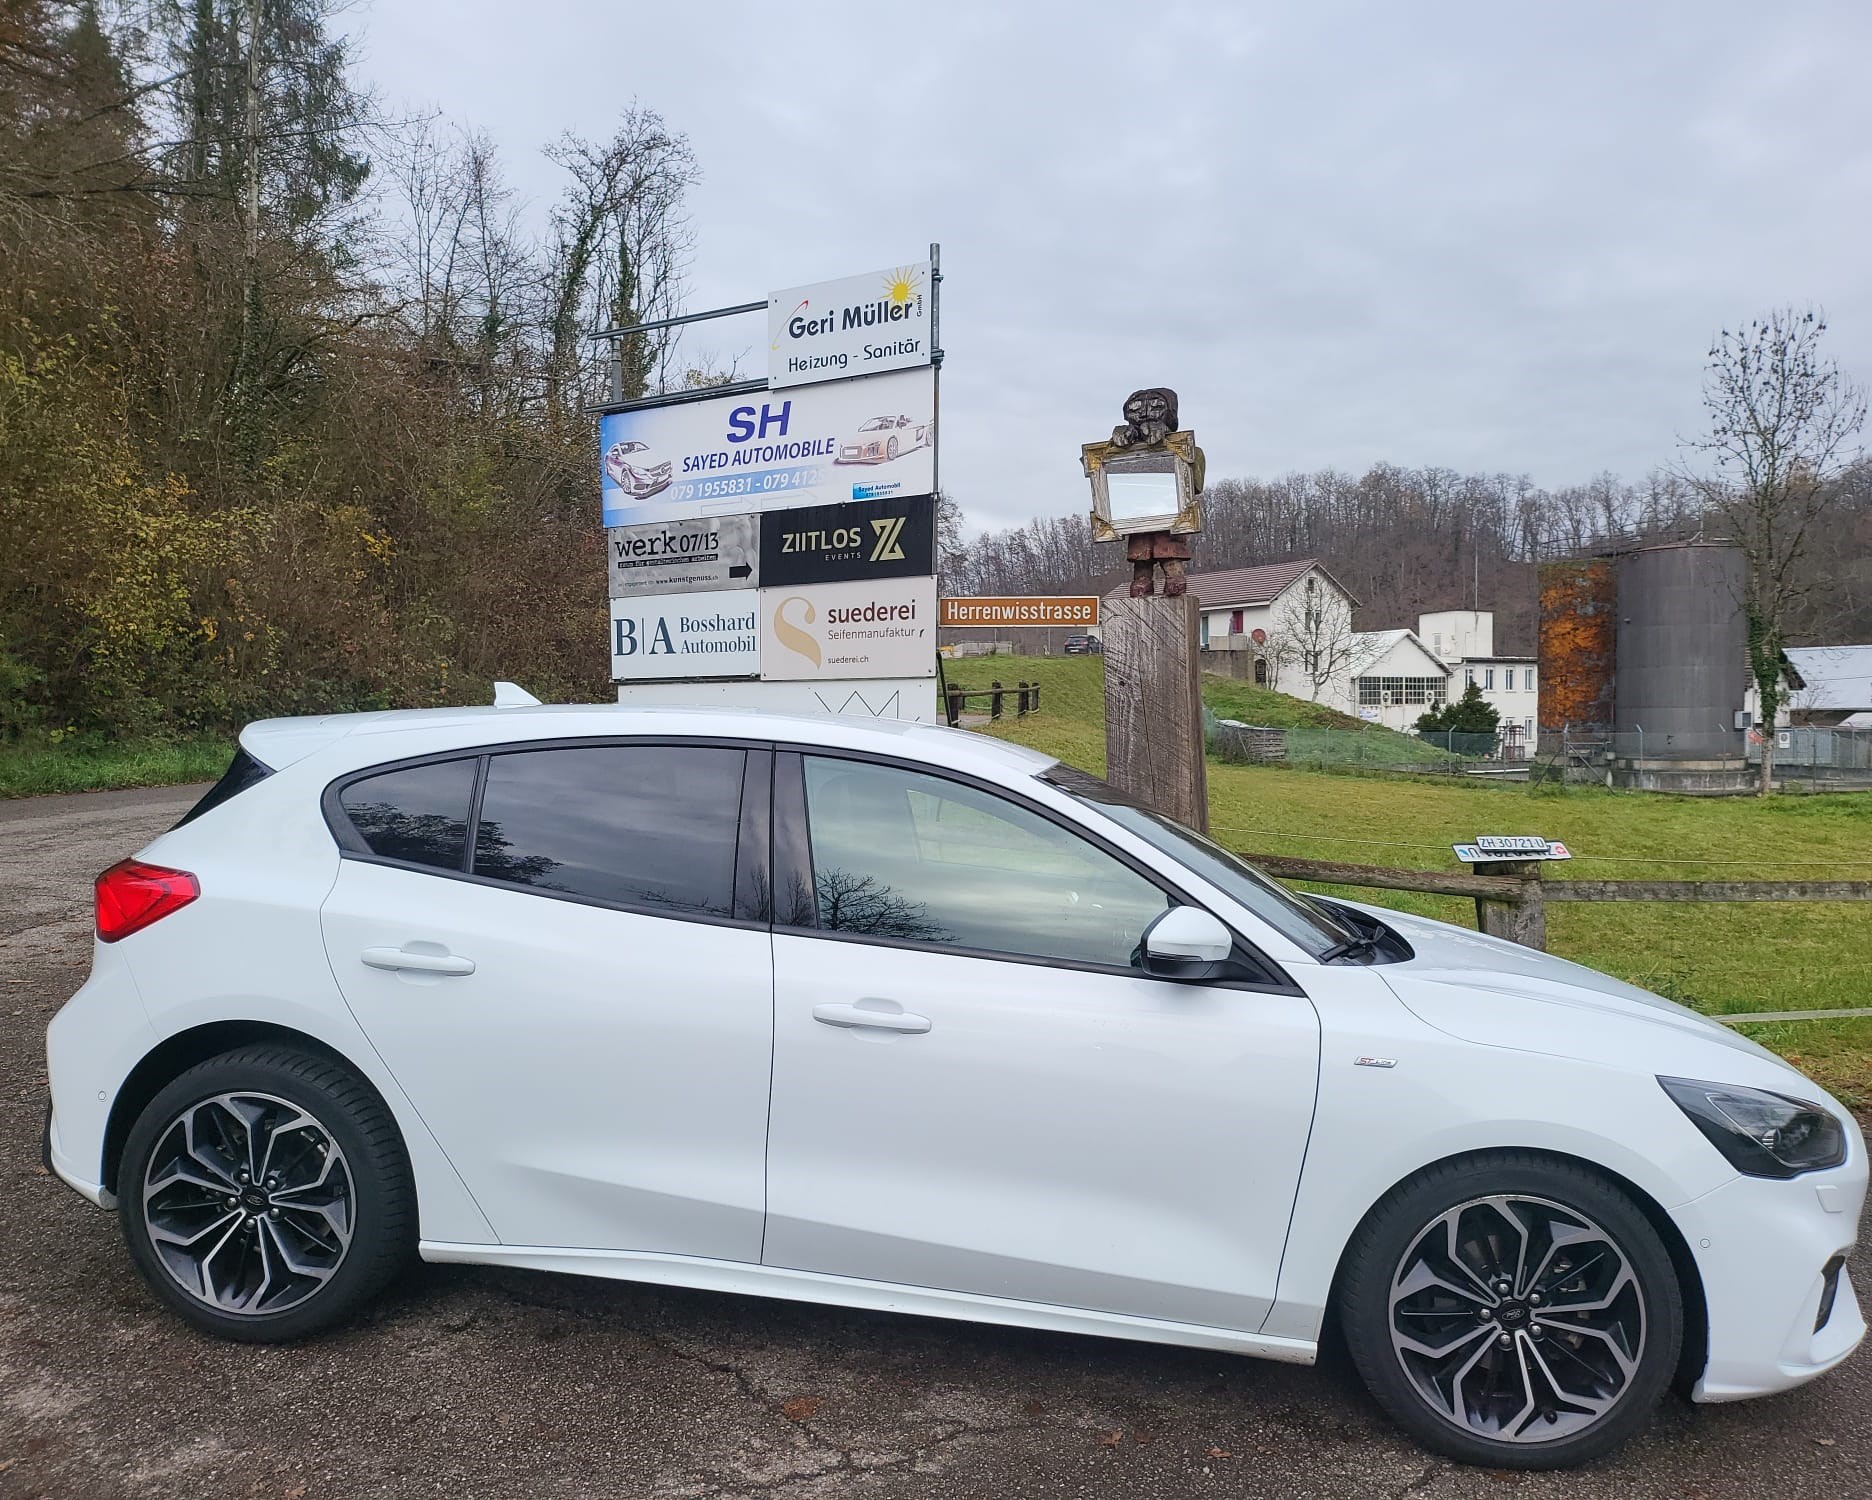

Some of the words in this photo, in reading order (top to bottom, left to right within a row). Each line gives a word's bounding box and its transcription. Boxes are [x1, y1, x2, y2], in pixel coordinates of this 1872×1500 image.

[788, 310, 834, 338] Geri
[842, 300, 913, 330] Müller
[788, 353, 848, 373] Heizung
[863, 338, 921, 360] Sanitär
[726, 400, 791, 443] SH
[682, 452, 729, 472] SAYED
[731, 437, 835, 466] AUTOMOBILE
[670, 484, 694, 500] 079
[697, 477, 752, 497] 1955831
[763, 473, 789, 490] 079
[615, 530, 677, 558] werk
[680, 532, 719, 553] 07/13
[782, 527, 861, 553] ZIITLOS
[825, 552, 861, 561] EVENTS
[680, 612, 755, 633] Bosshard
[828, 599, 916, 624] suederei
[947, 601, 1091, 620] Herrenwisstrasse
[681, 635, 756, 654] Automobil
[828, 627, 915, 640] Seifenmanufaktur
[828, 655, 869, 664] suederei.ch
